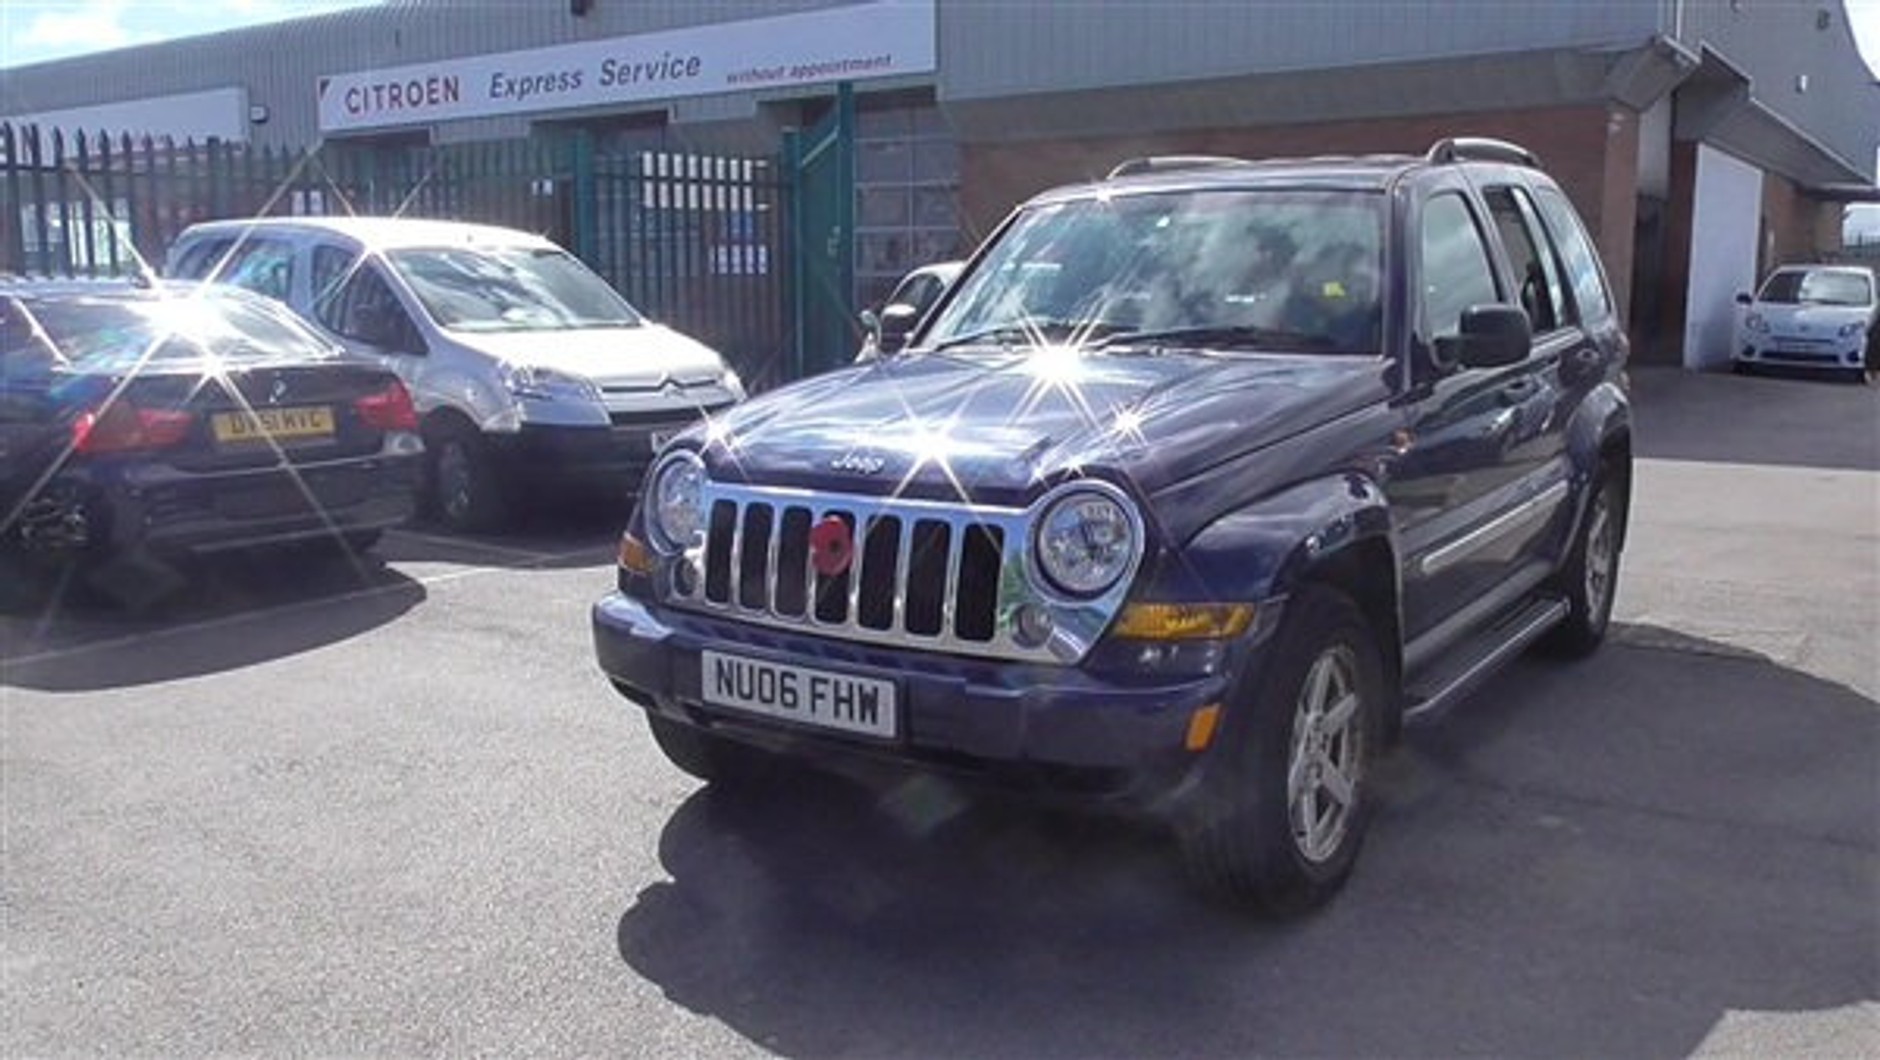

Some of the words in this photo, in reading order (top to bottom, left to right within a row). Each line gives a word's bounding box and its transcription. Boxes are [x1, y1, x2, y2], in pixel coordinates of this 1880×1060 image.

[488, 71, 583, 101] Express
[599, 51, 702, 87] Service
[726, 65, 785, 84] without
[789, 53, 892, 80] appointment
[830, 446, 885, 475] Jeep
[715, 656, 798, 709] NU06
[810, 675, 879, 726] FHW
